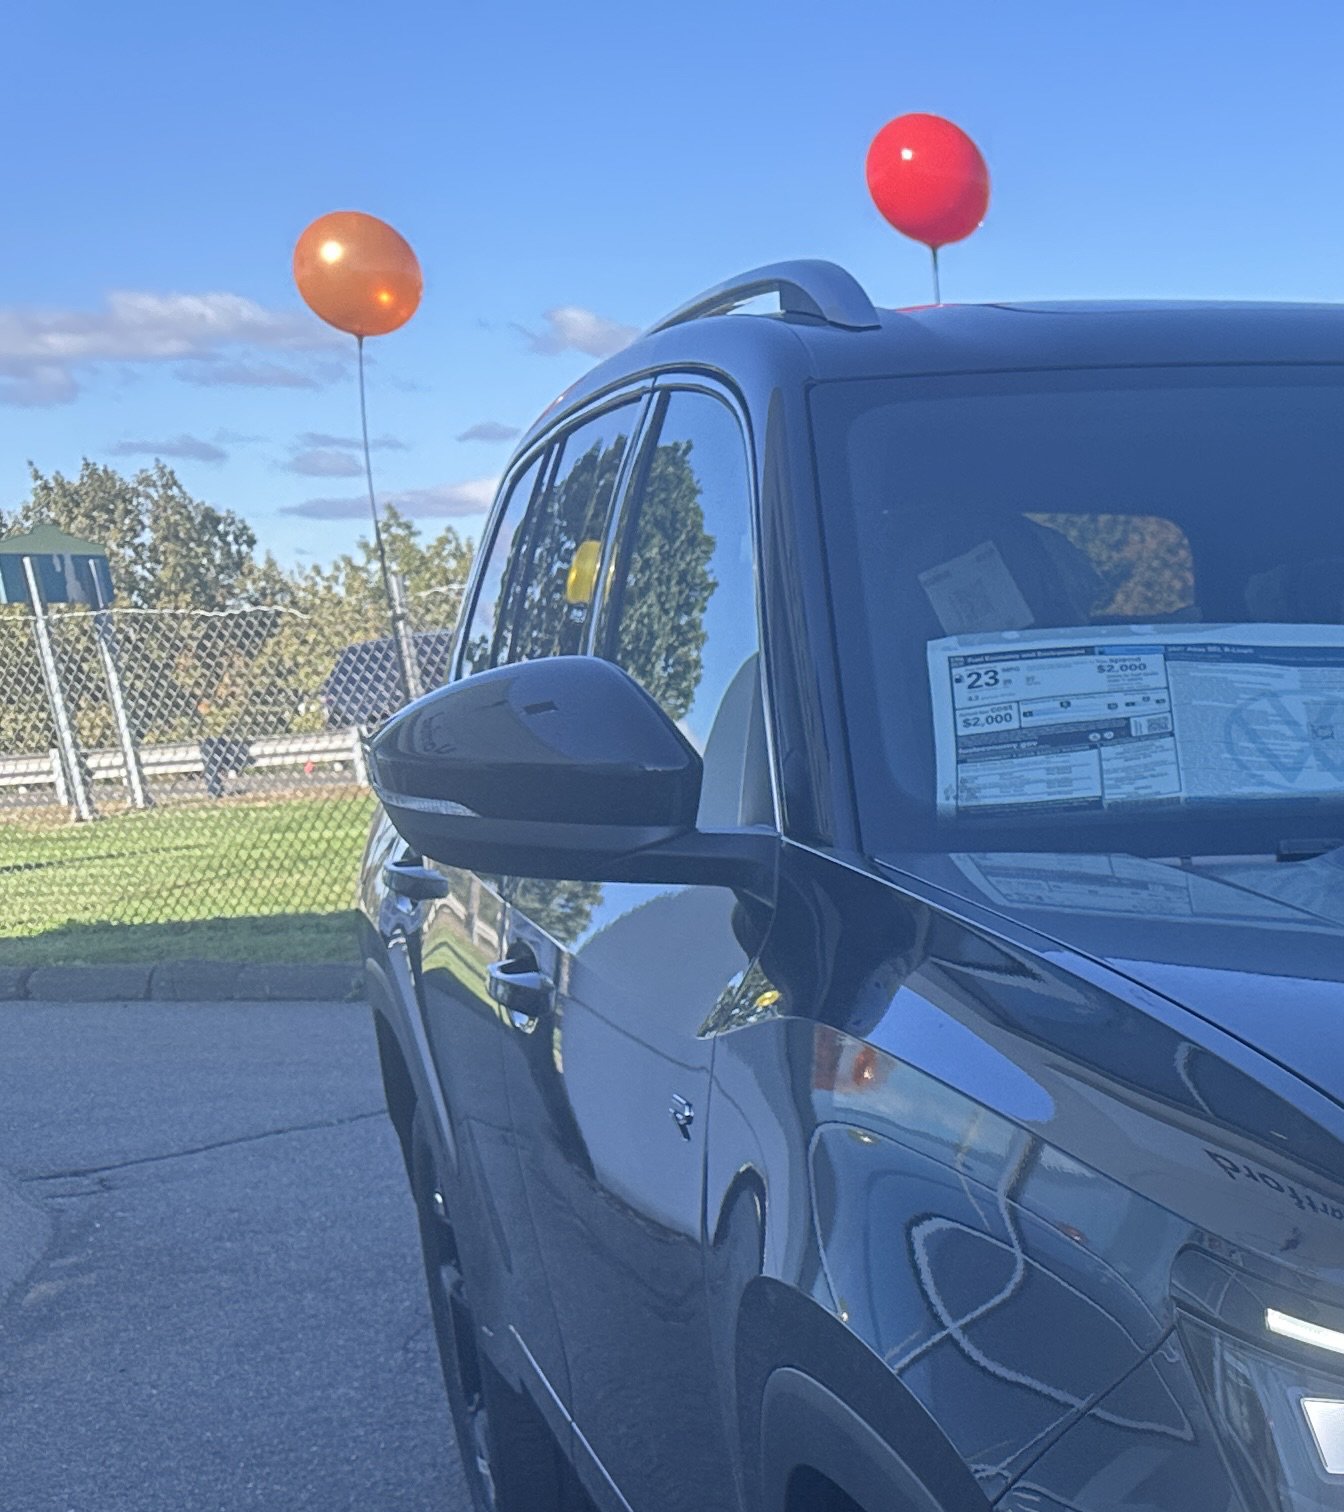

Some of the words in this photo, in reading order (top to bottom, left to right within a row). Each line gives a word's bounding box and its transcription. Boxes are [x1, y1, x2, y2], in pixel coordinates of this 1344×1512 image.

[1097, 663, 1147, 674] $2,000
[966, 669, 1000, 690] 23
[962, 712, 1014, 729] $2,000
